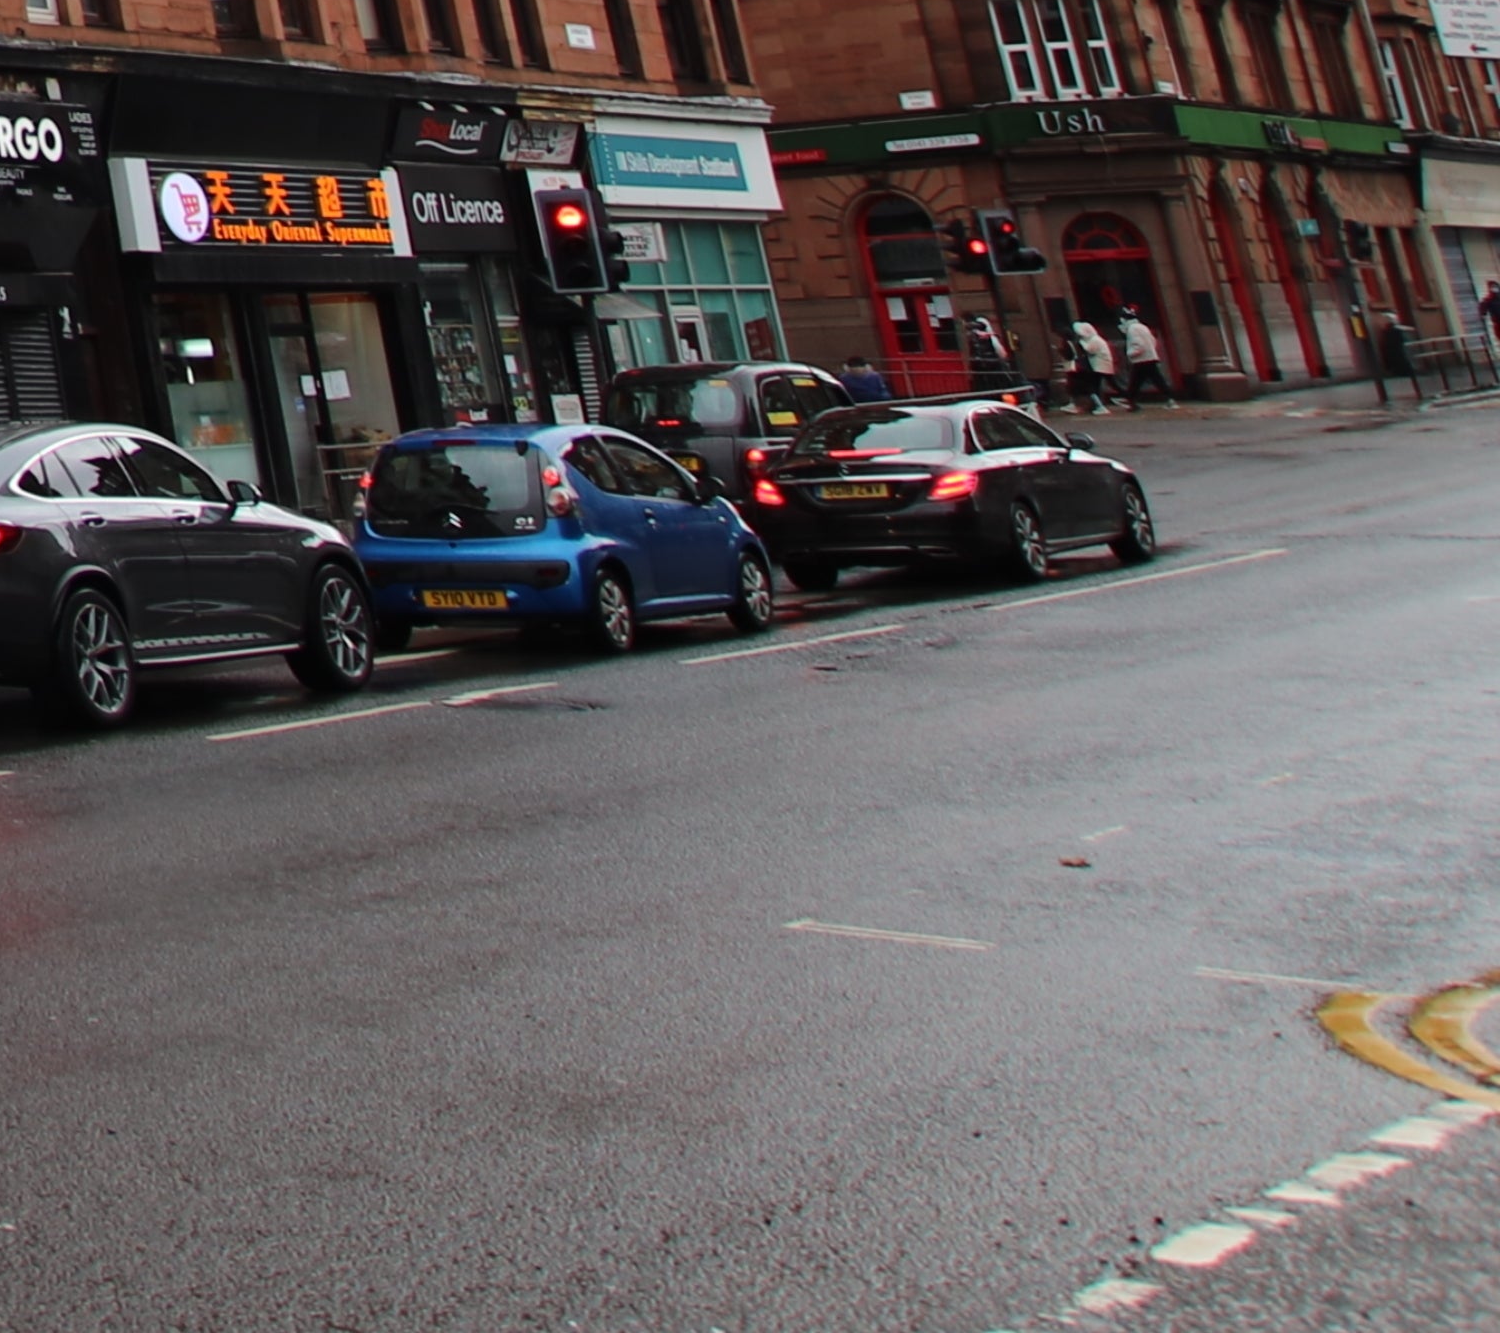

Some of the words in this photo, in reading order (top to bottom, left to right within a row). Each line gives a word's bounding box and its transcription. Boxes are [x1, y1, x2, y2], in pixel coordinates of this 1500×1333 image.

[1036, 108, 1106, 134] Ush
[206, 170, 391, 219] 天天超市
[413, 192, 440, 223] Off
[441, 193, 504, 224] Licence
[431, 591, 463, 606] SY10
[465, 591, 497, 606] VTD
